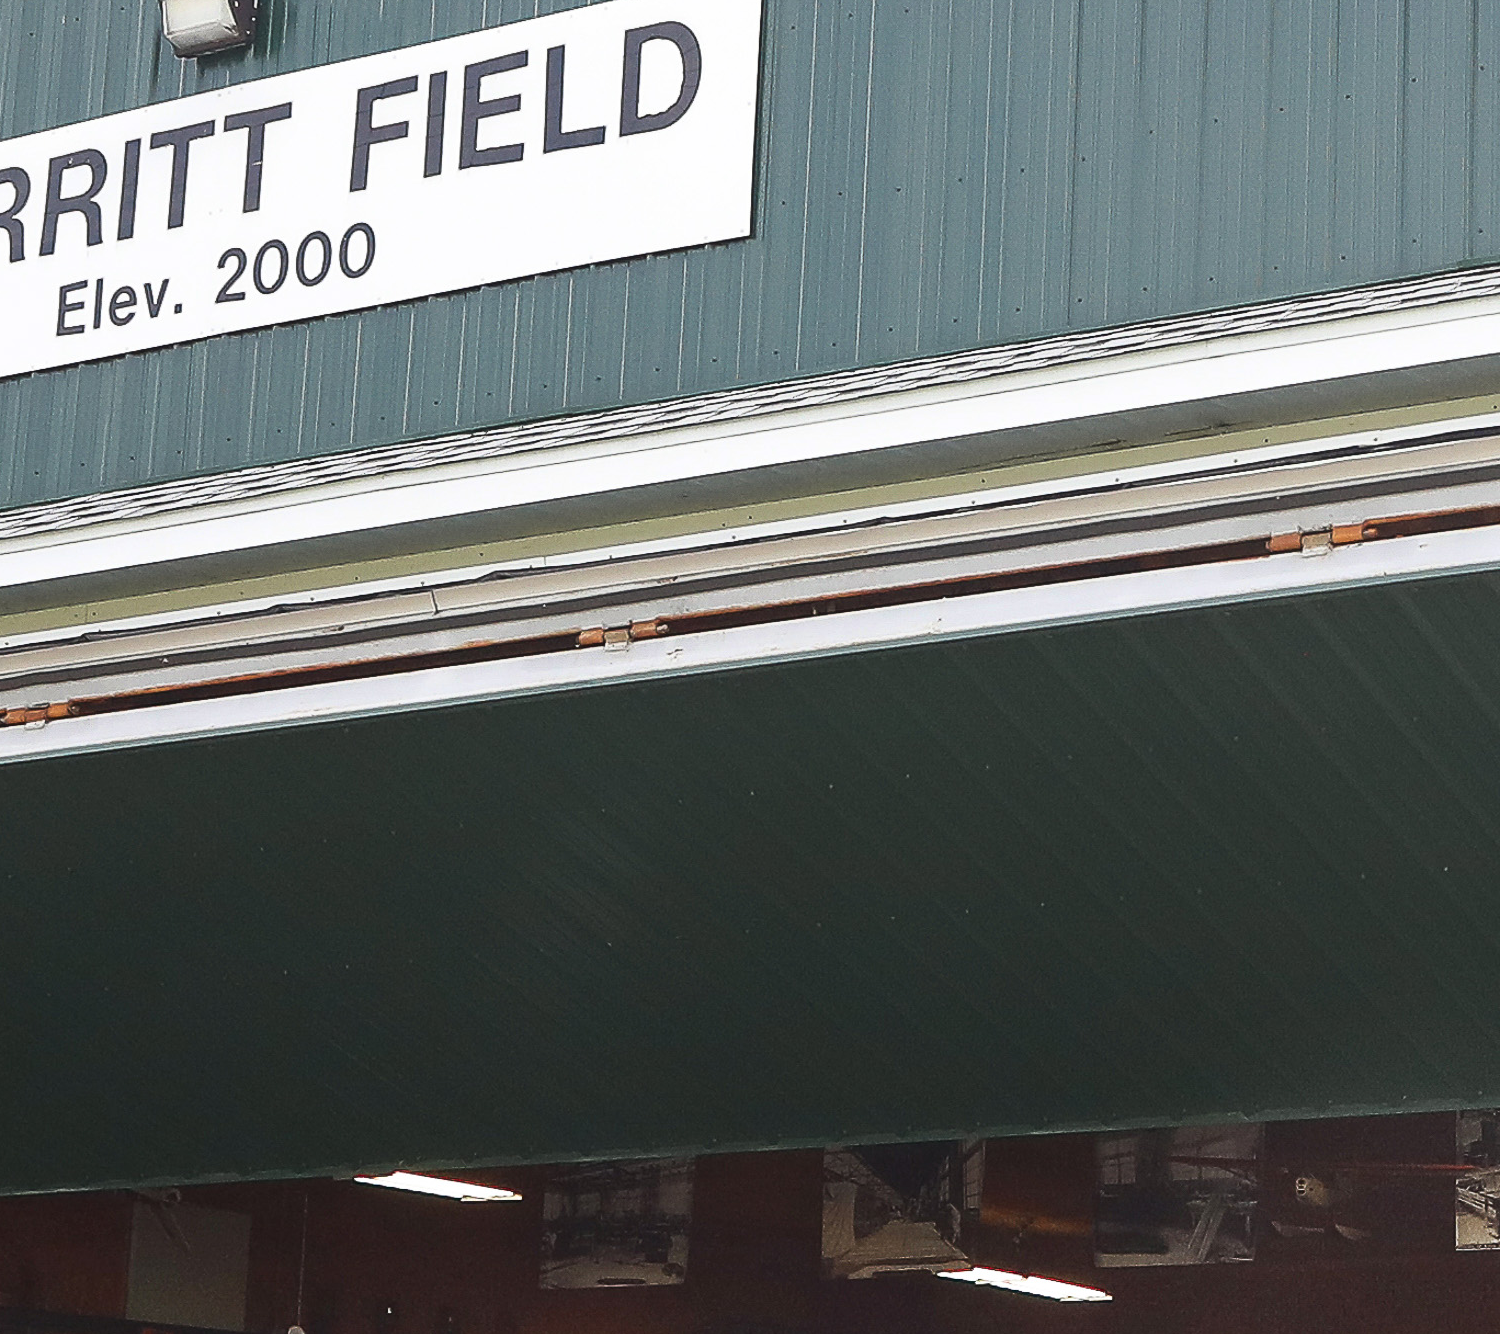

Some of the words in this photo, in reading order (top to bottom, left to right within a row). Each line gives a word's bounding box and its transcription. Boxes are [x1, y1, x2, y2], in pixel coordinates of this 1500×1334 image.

[348, 19, 703, 193] FIELD
[53, 275, 184, 338] Elev.
[215, 220, 377, 305] 2000
